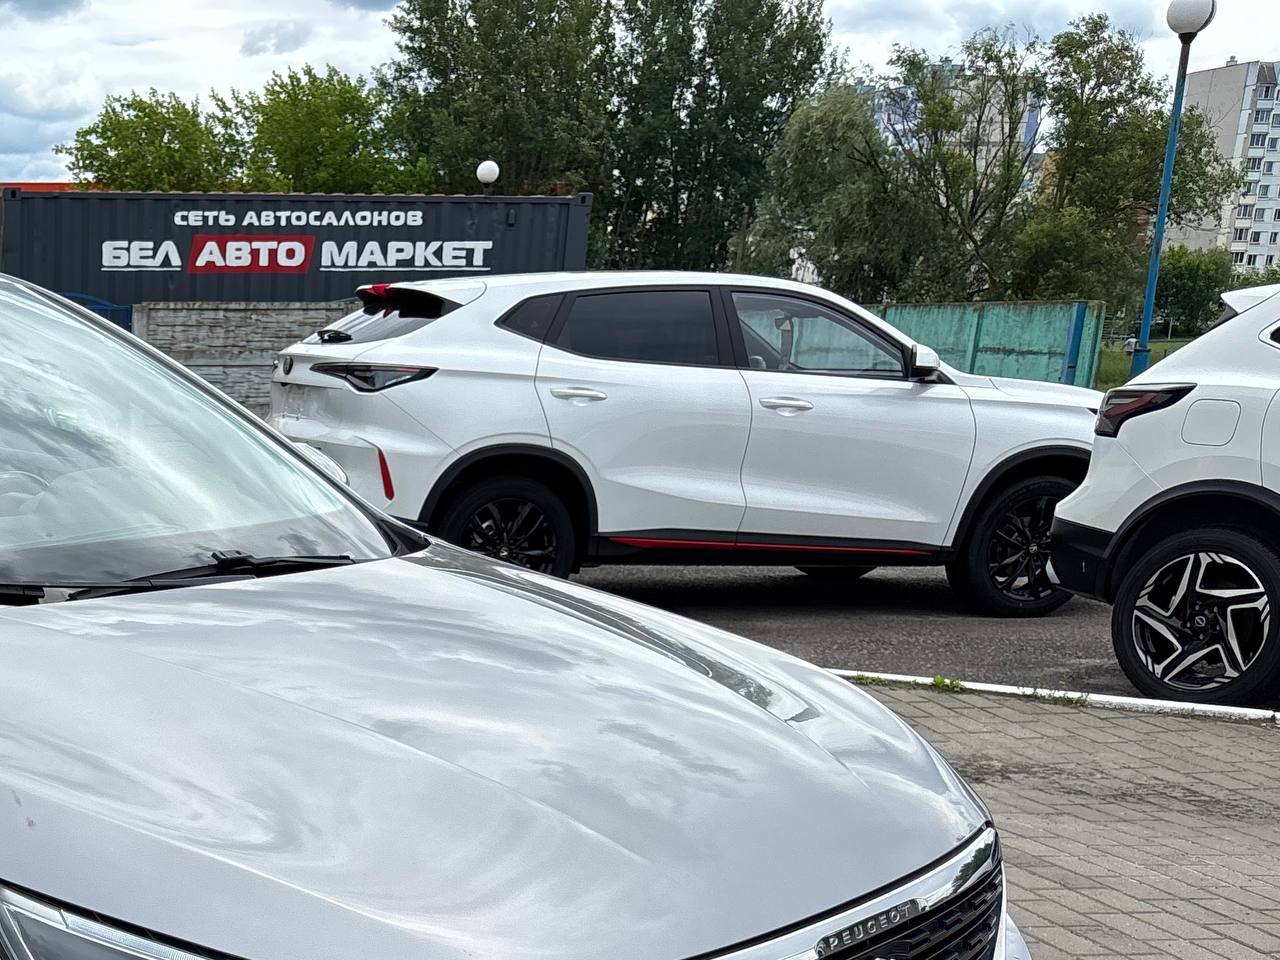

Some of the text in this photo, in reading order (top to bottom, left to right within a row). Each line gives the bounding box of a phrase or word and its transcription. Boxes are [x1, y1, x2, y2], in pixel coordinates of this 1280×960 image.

[174, 210, 423, 227] СЕТЬ АВТОСАЛОНОВ
[101, 240, 493, 267] БЕЛ АВТО МАРКЕТ
[828, 900, 912, 951] PEUGEOT
